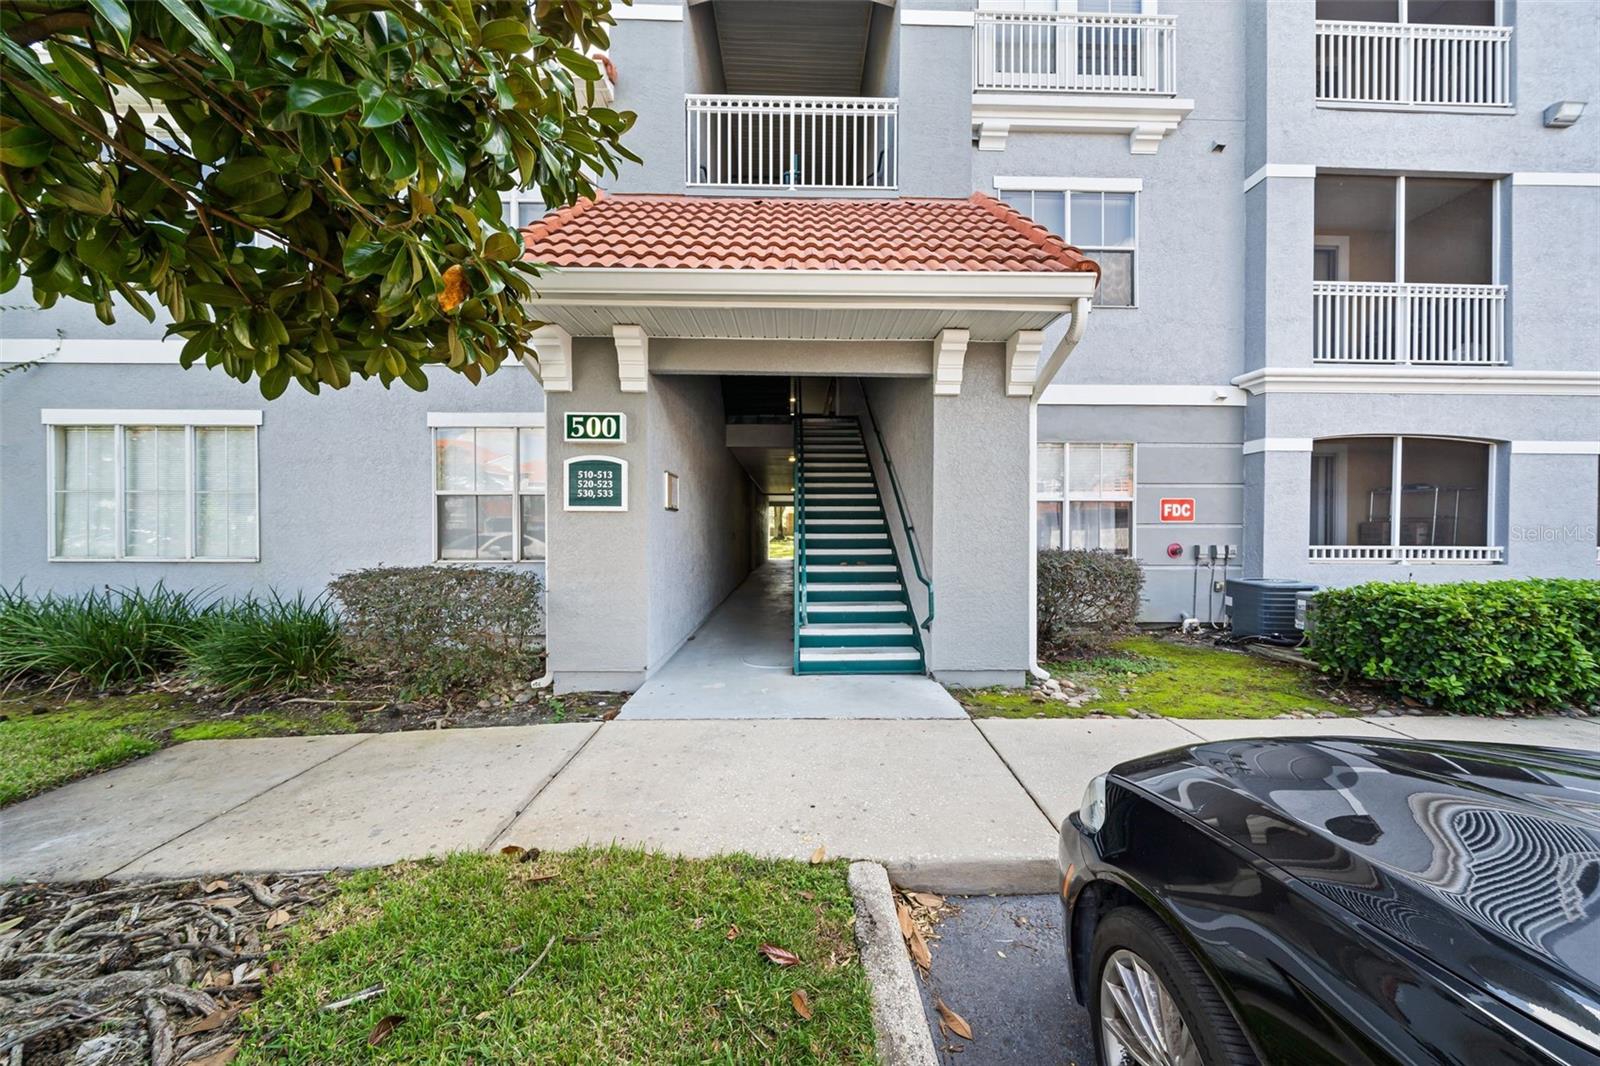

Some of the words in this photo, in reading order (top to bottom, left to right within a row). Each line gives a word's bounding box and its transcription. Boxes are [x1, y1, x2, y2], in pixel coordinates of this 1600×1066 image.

[571, 416, 617, 438] 500
[577, 470, 613, 479] 510-513
[577, 480, 613, 488] 520-523
[577, 489, 596, 499] 530,
[597, 489, 613, 498] 533
[1163, 503, 1191, 517] FDC
